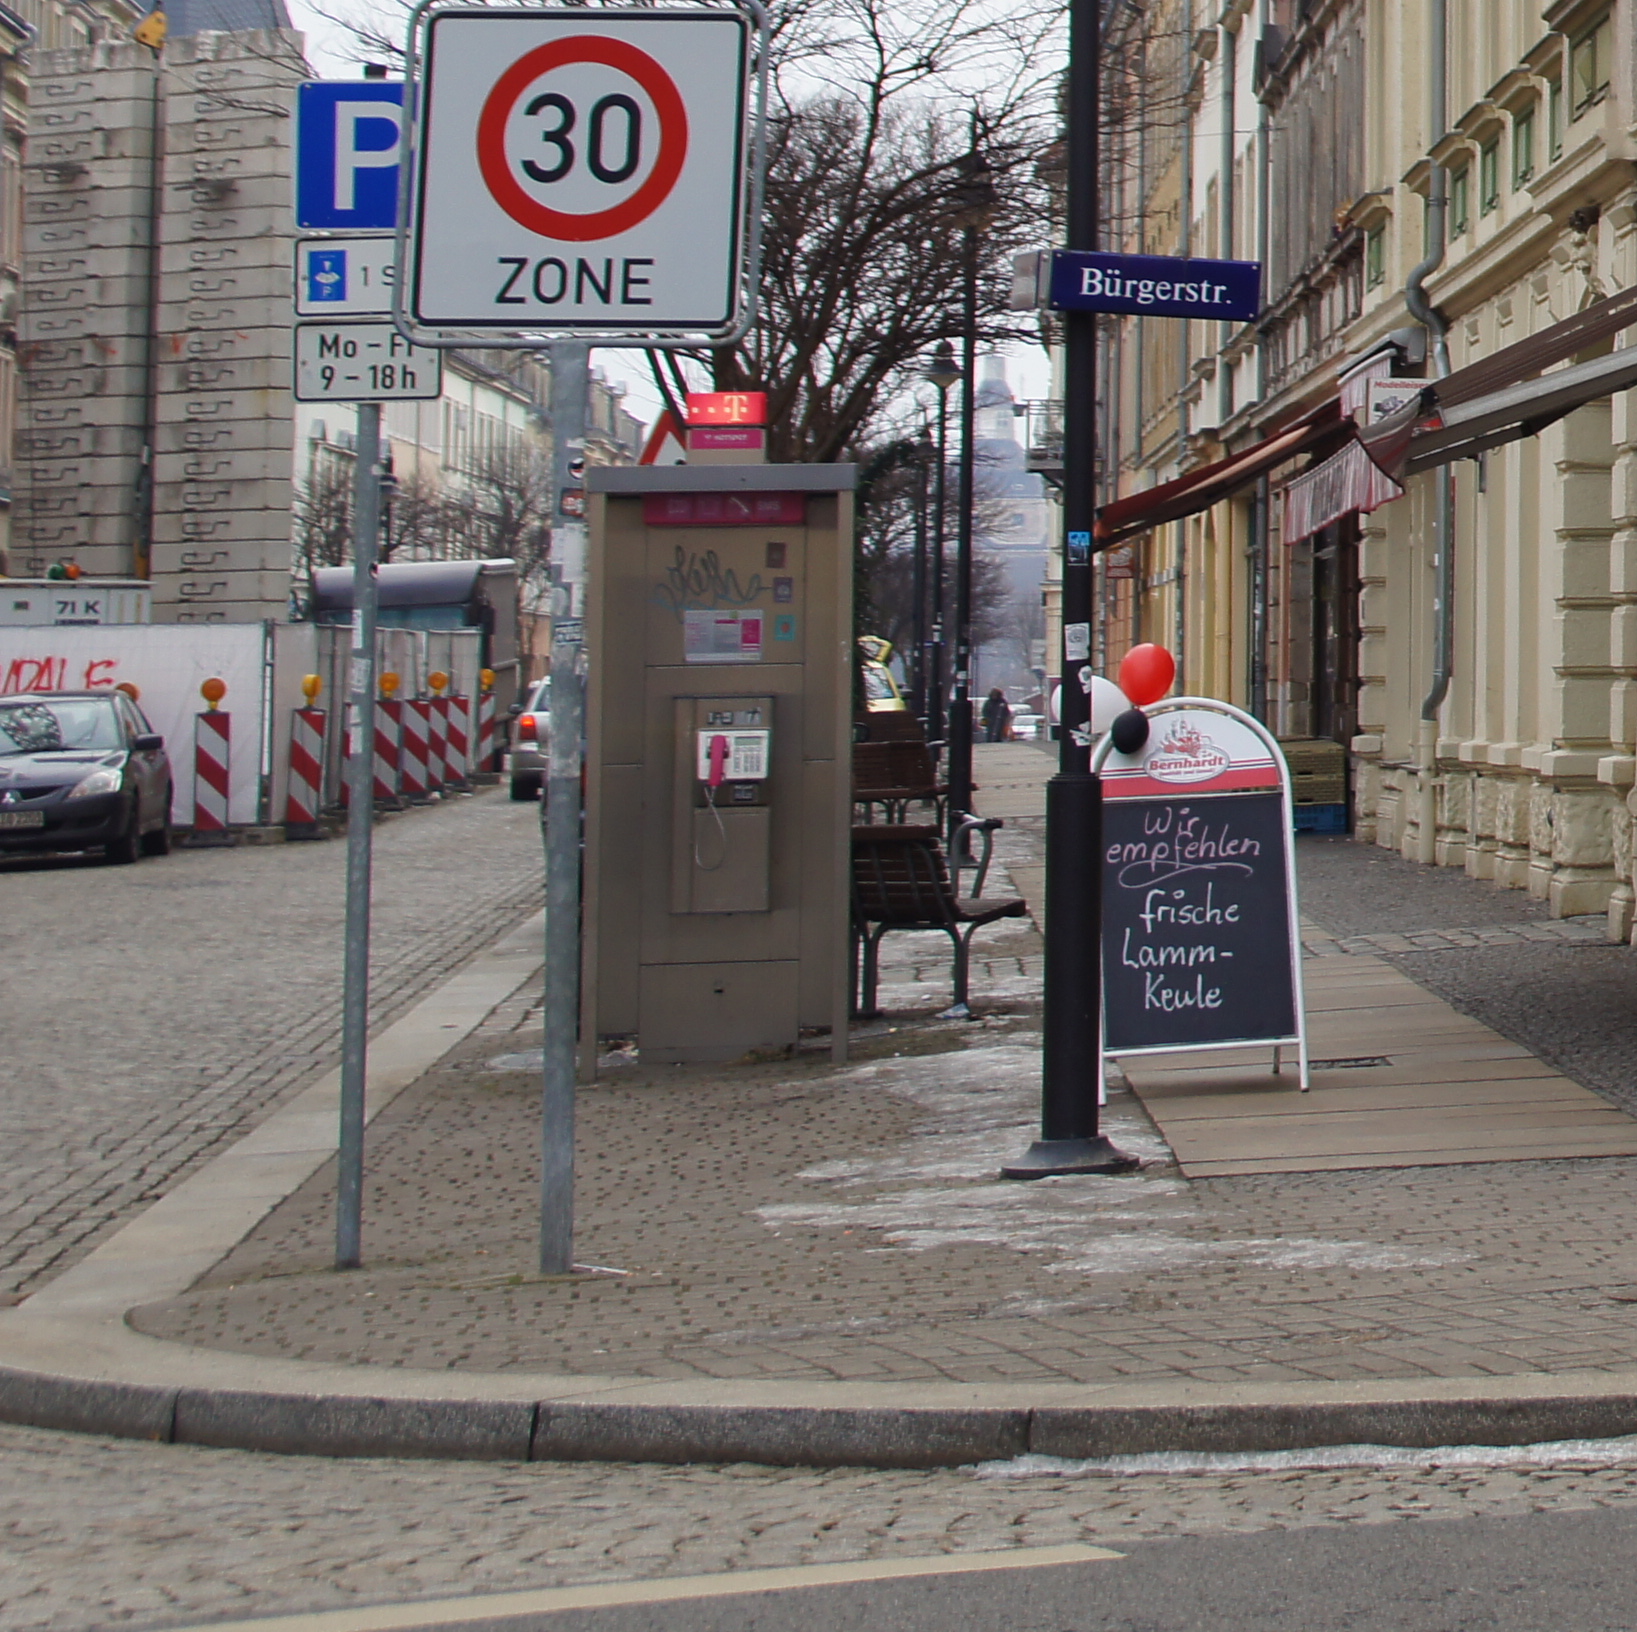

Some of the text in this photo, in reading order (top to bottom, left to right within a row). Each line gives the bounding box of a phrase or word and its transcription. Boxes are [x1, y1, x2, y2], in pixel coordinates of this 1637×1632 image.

[332, 100, 402, 212] P
[520, 90, 642, 185] 30
[495, 256, 654, 306] ZONE
[1078, 265, 1233, 307] Bürgerstr.
[318, 333, 357, 359] Mo
[320, 365, 335, 392] 9
[84, 600, 101, 615] K
[1149, 755, 1225, 771] Bernhardt
[1143, 806, 1200, 836] Wir
[1105, 825, 1262, 874] empfehlen
[1138, 881, 1240, 935] frische
[1122, 927, 1234, 969] Lamm-
[1144, 972, 1223, 1012] Keule
